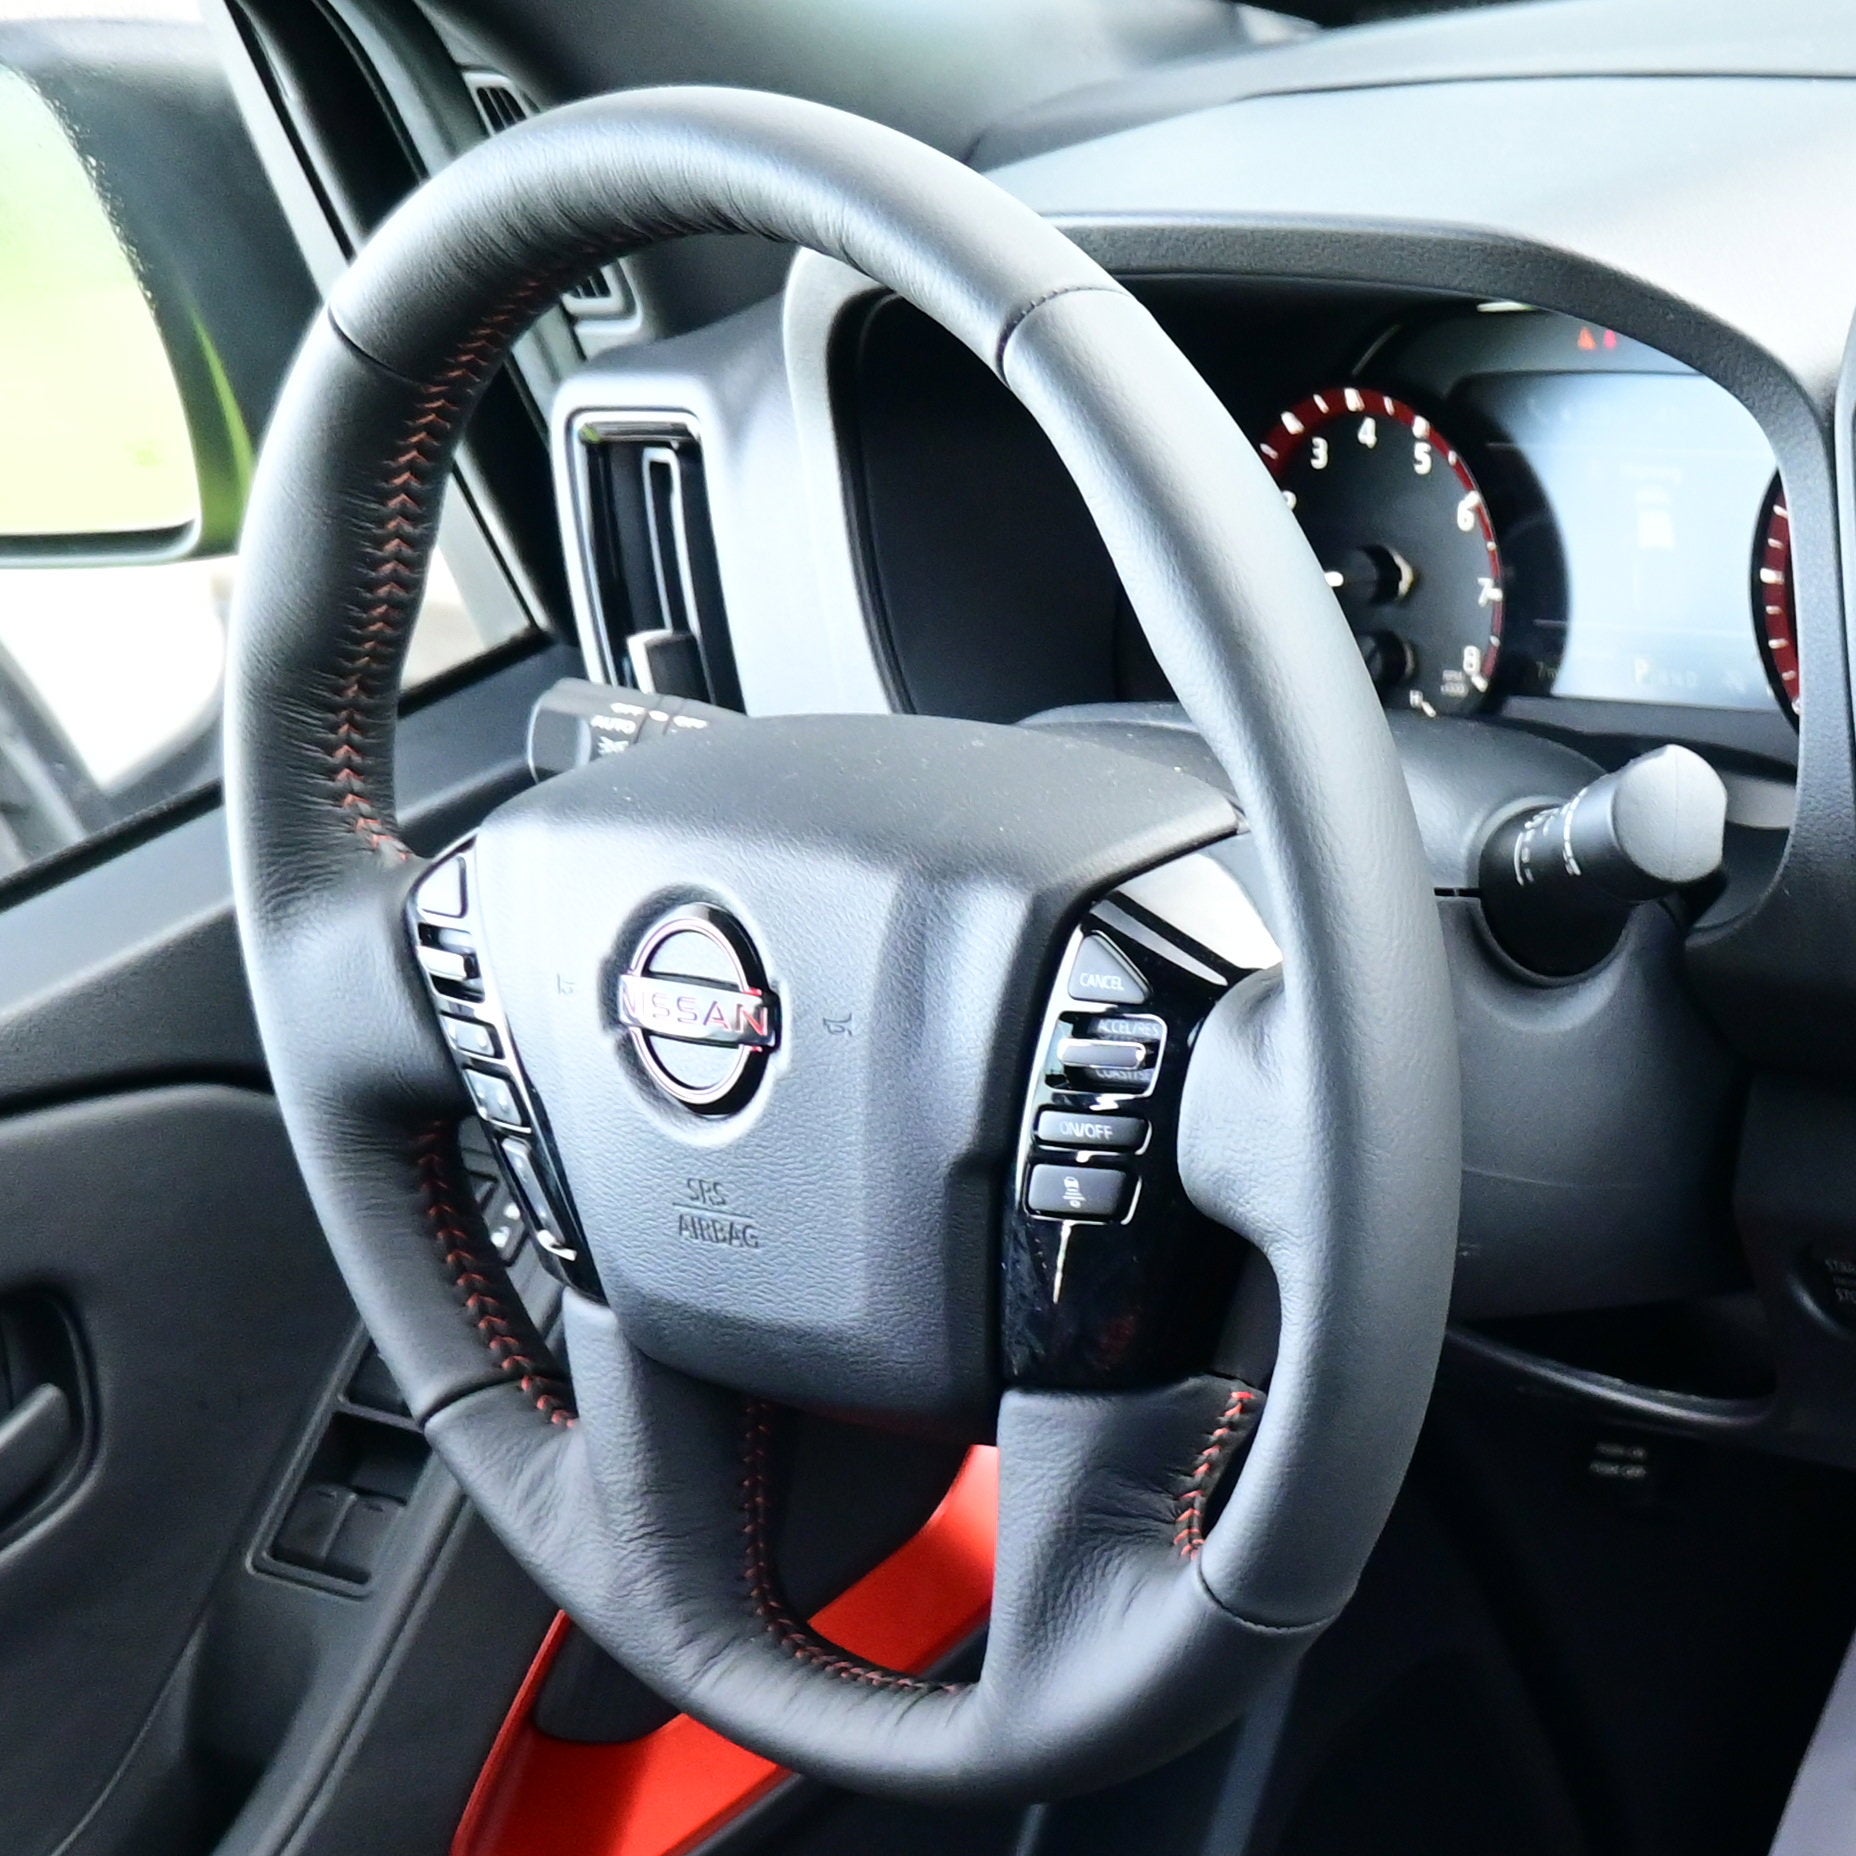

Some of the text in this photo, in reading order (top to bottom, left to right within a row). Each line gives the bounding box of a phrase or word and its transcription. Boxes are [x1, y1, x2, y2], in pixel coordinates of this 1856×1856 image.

[1357, 417, 1377, 448] 4
[1311, 437, 1328, 470] 3
[1413, 442, 1432, 475] 5
[1079, 973, 1124, 990] CANCEL
[621, 985, 768, 1036] NISSAN
[1059, 1120, 1113, 1140] ON/OFF
